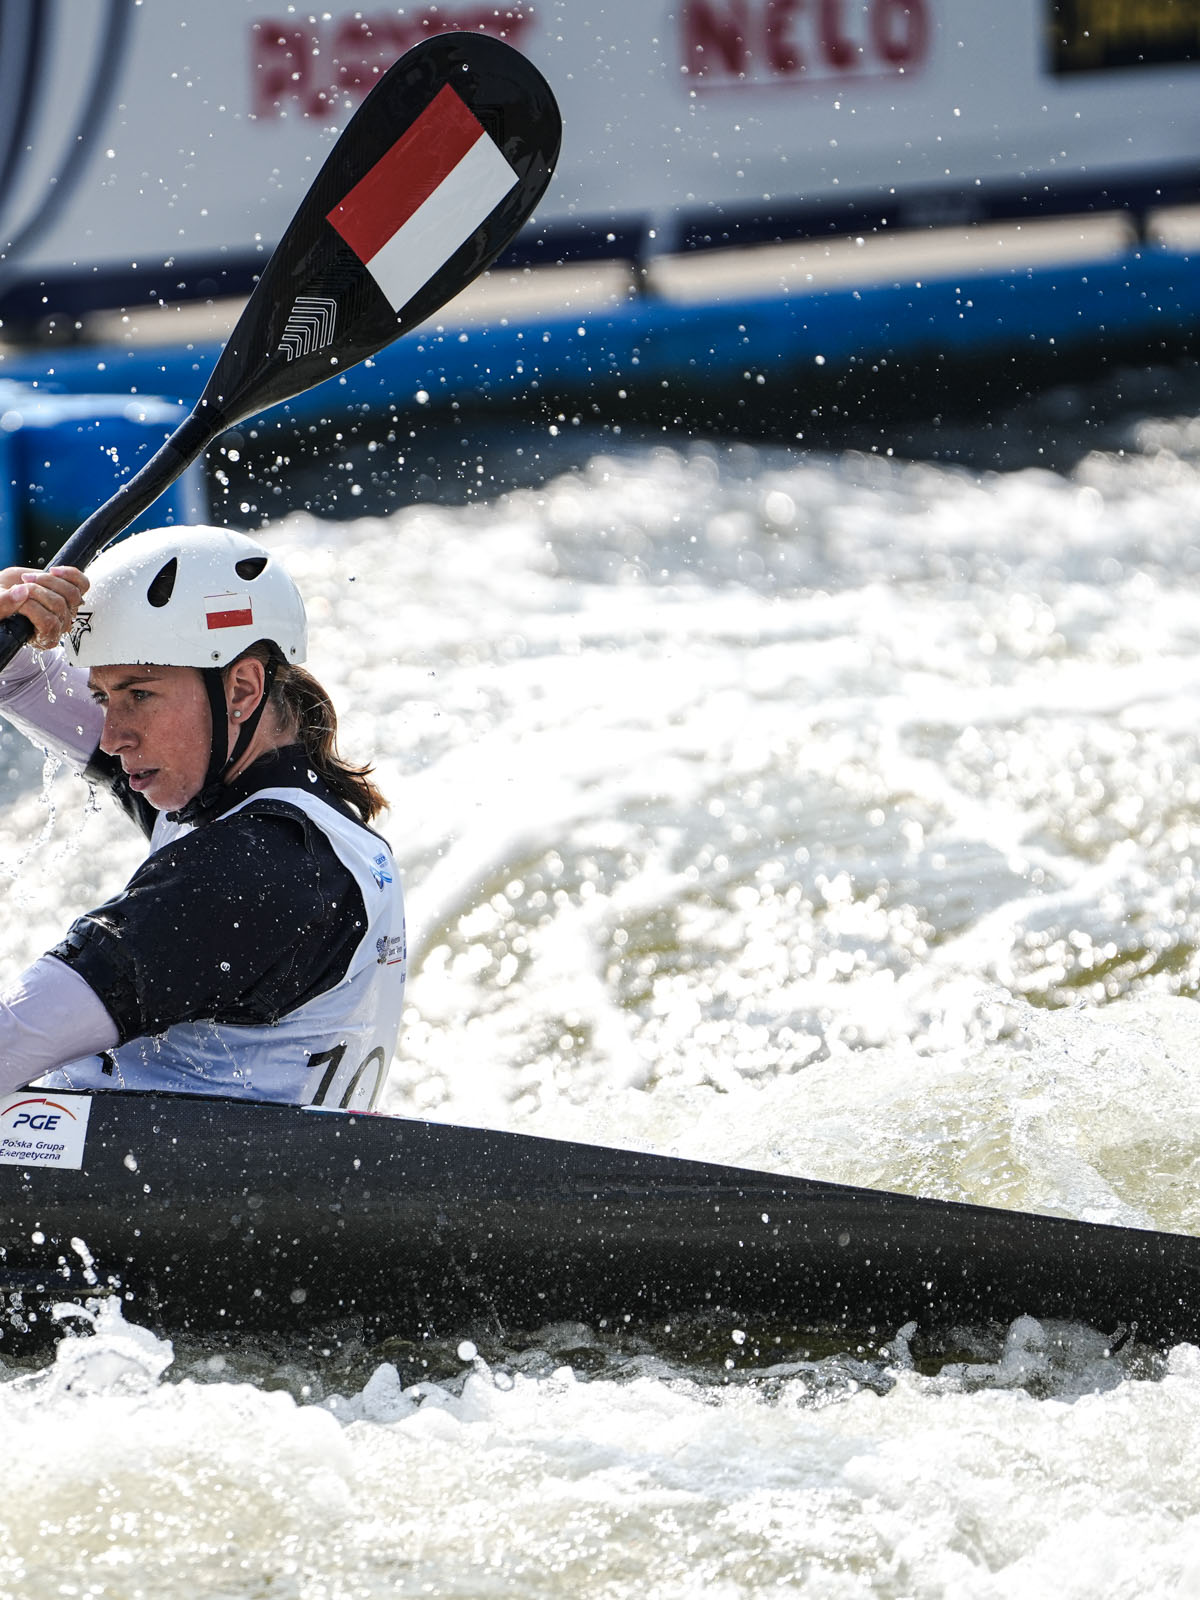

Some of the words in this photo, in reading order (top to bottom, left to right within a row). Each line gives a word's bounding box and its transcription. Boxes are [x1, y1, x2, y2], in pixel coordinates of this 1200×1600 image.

[684, 0, 930, 74] NELO
[13, 1113, 61, 1130] PGE
[2, 1139, 32, 1149] Polska
[35, 1141, 65, 1152] Grupa
